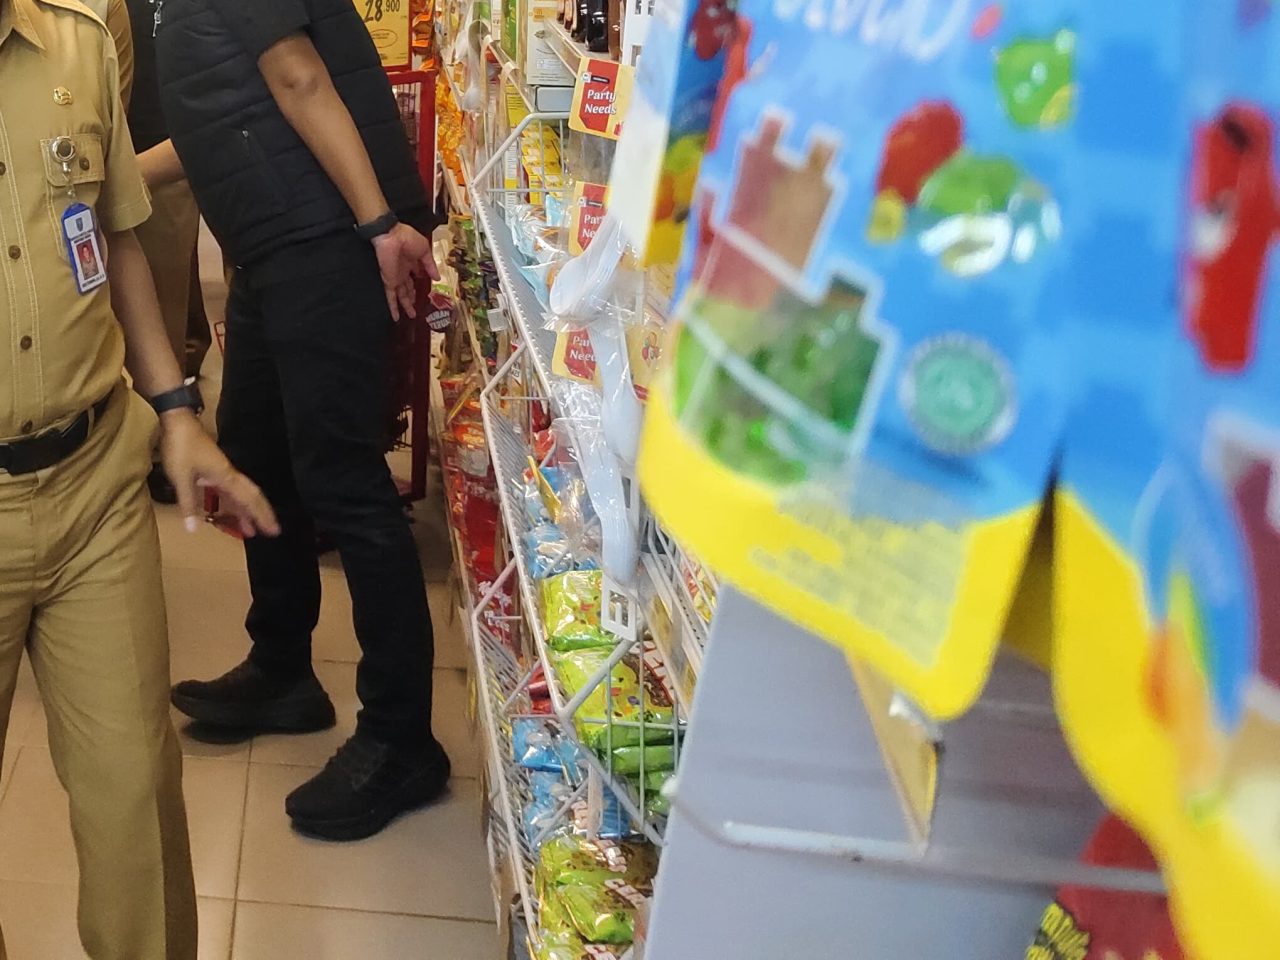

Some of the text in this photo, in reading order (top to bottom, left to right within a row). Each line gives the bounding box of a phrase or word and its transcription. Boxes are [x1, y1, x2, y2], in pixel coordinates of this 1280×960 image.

[587, 88, 617, 103] Party
[585, 103, 617, 115] Needs
[584, 214, 604, 225] Par
[573, 334, 591, 347] Par
[570, 349, 597, 362] Need
